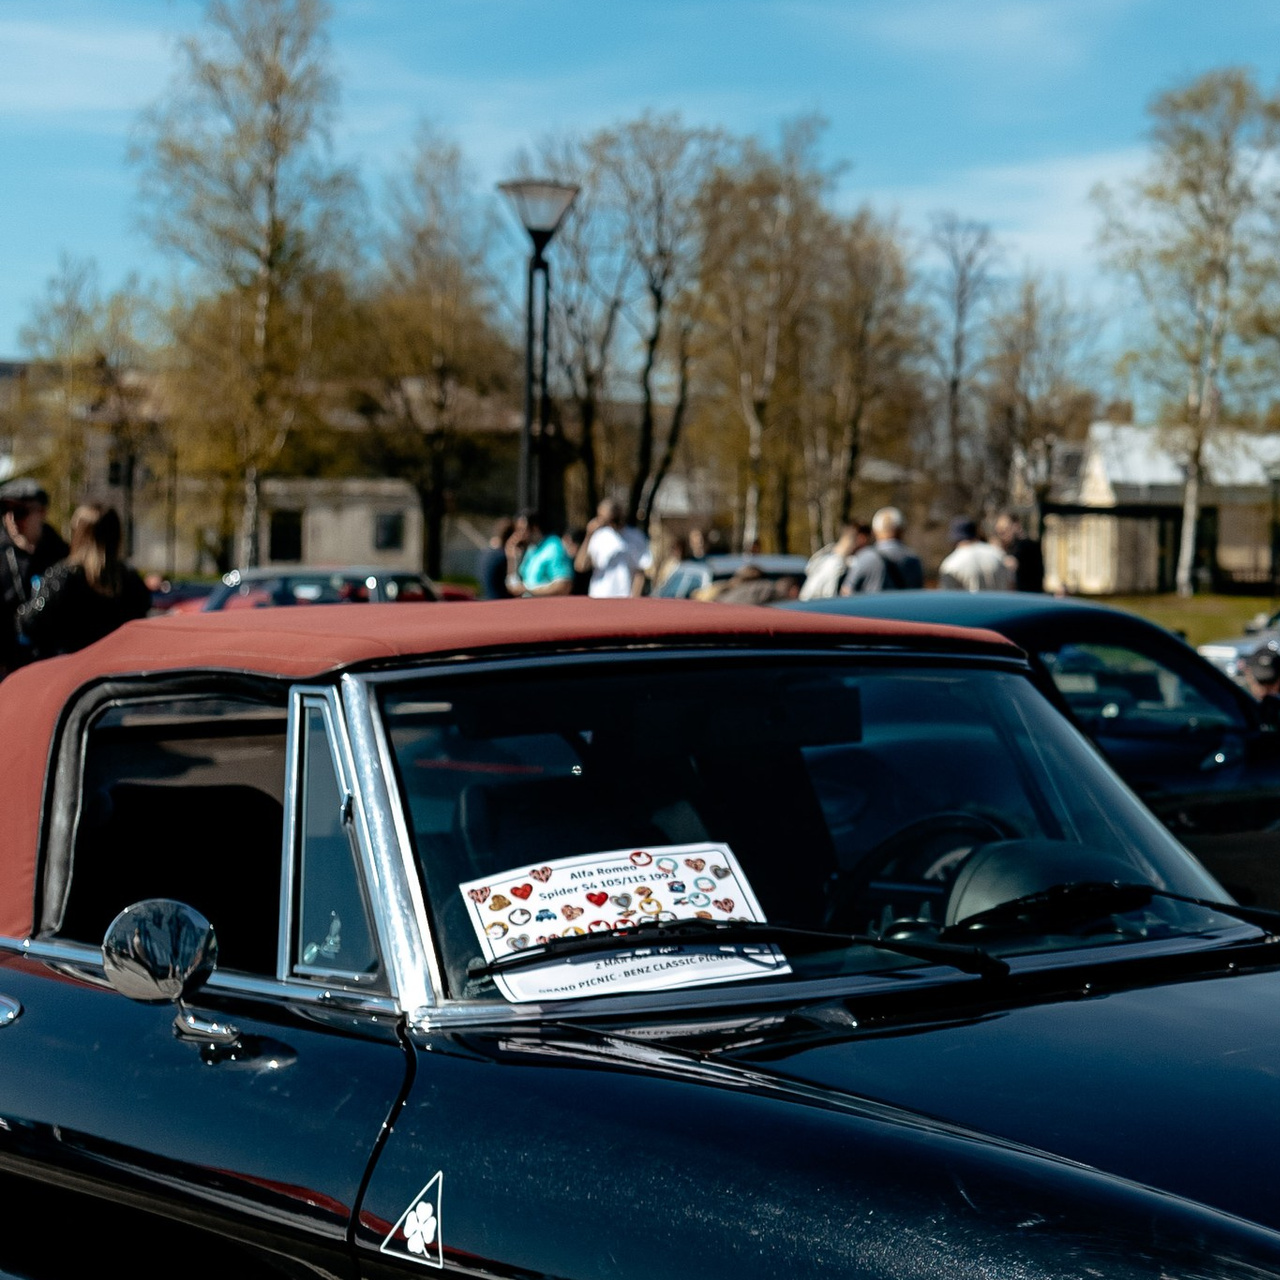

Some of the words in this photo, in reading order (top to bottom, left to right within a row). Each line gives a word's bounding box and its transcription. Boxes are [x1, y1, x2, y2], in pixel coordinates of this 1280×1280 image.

[570, 870, 594, 881] Alfa
[596, 865, 637, 877] Romeo
[539, 885, 579, 901] Spider
[581, 883, 598, 892] S4
[601, 874, 647, 888] 105/115
[579, 973, 617, 989] PICNIC
[623, 965, 652, 978] BENZ
[653, 956, 698, 971] CLASSIC
